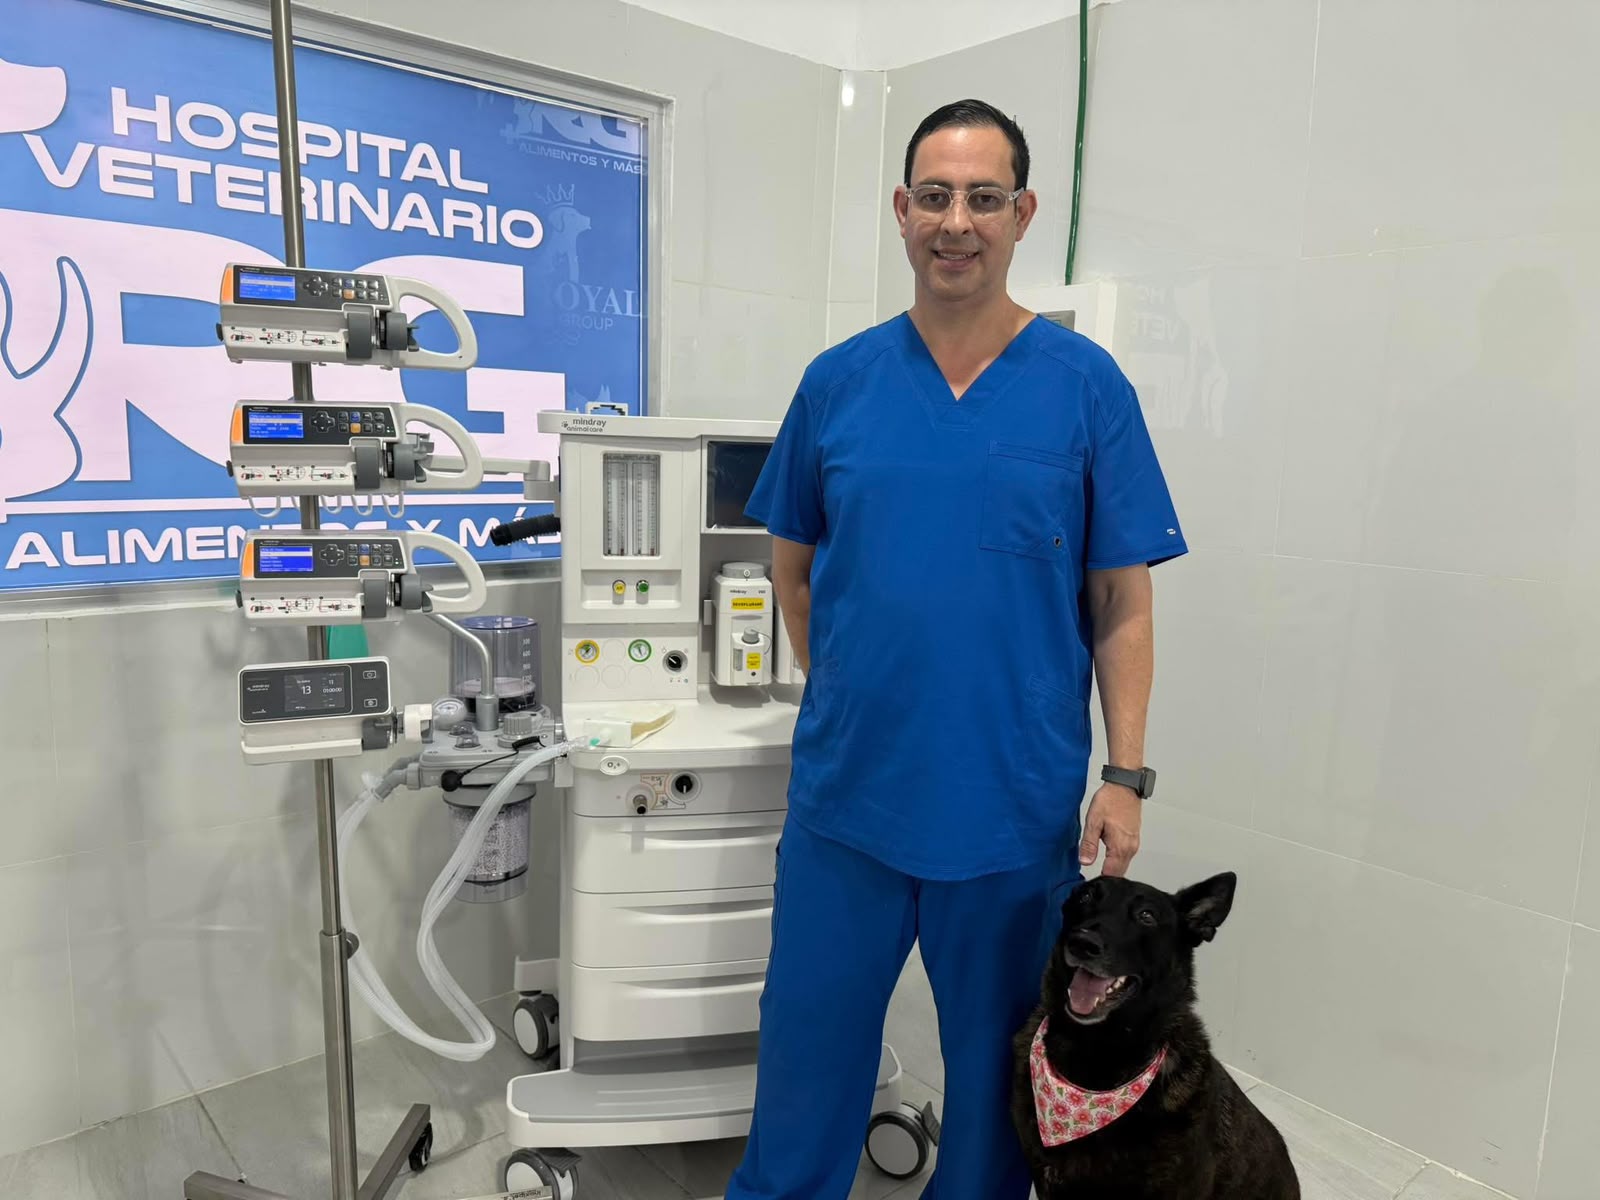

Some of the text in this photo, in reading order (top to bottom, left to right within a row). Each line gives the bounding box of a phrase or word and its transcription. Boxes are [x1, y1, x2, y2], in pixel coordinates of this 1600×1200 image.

[111, 86, 489, 194] HOSPITAL
[601, 158, 610, 169] Y
[22, 133, 544, 249] VETERINARIO
[556, 281, 641, 318] OYAL
[572, 417, 607, 428] mindray
